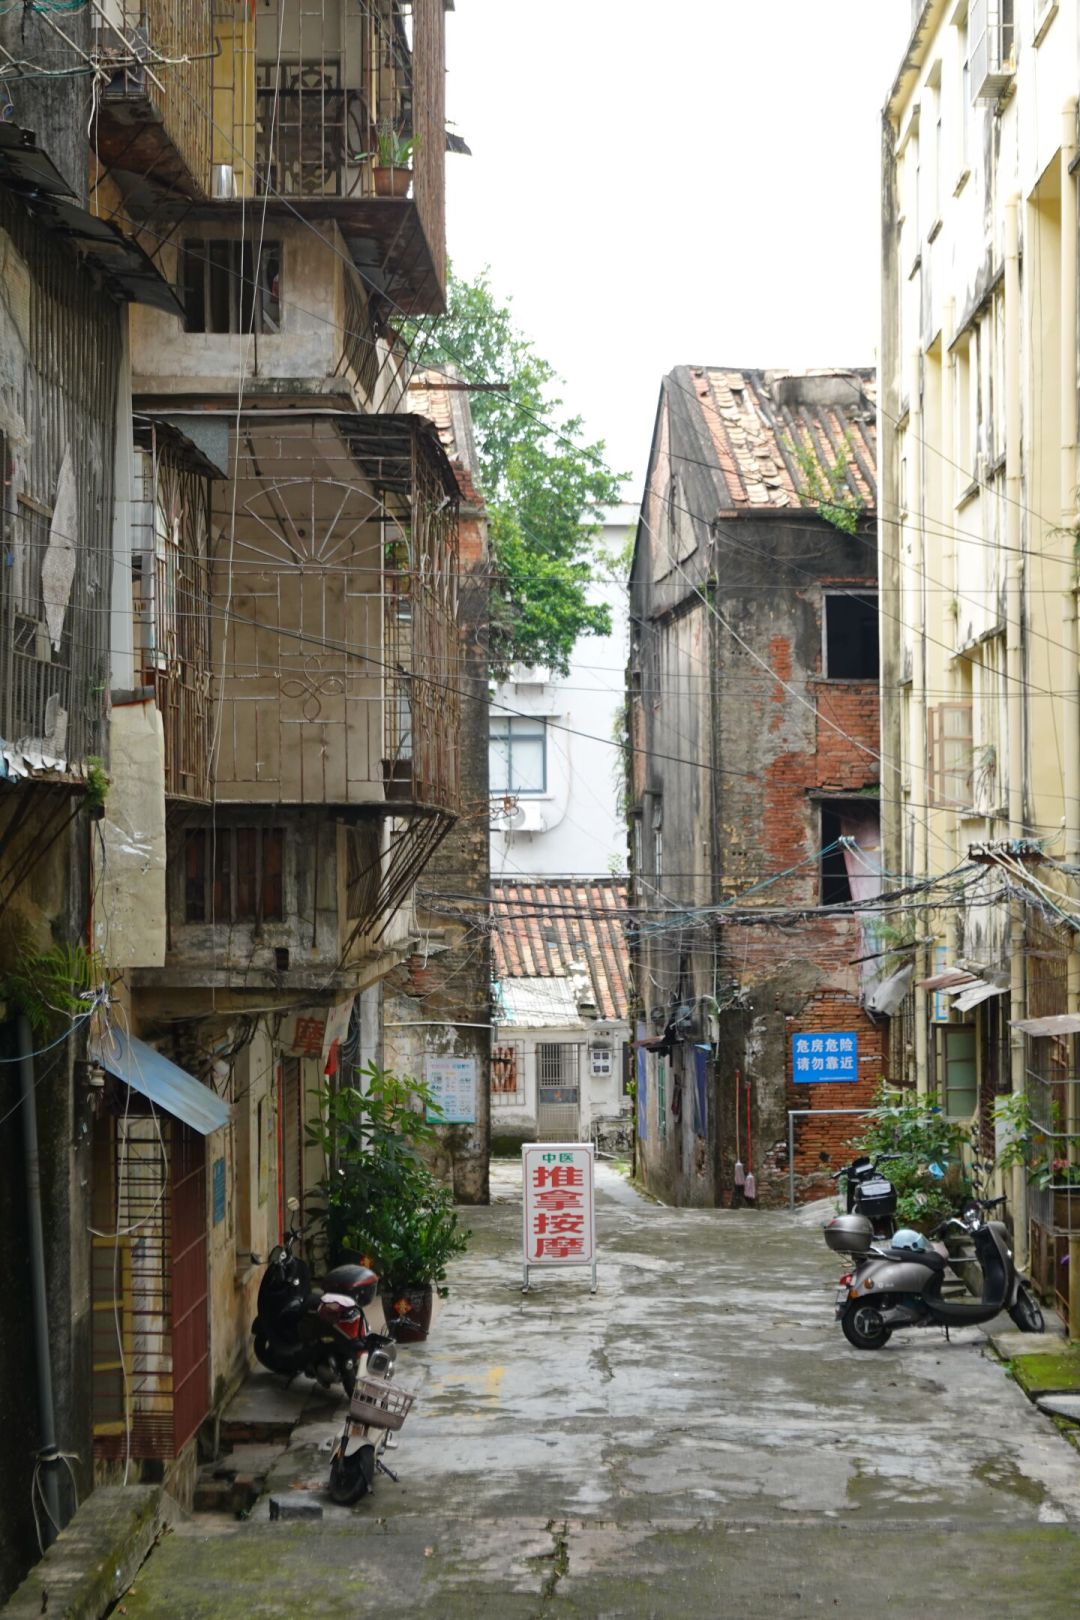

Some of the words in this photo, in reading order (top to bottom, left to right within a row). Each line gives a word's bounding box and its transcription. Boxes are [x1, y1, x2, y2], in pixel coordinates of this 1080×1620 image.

[796, 1038, 853, 1053] 危房危险
[796, 1056, 854, 1071] 请勿靠近
[542, 1152, 574, 1164] 中医
[532, 1166, 585, 1258] 推拿按摩
